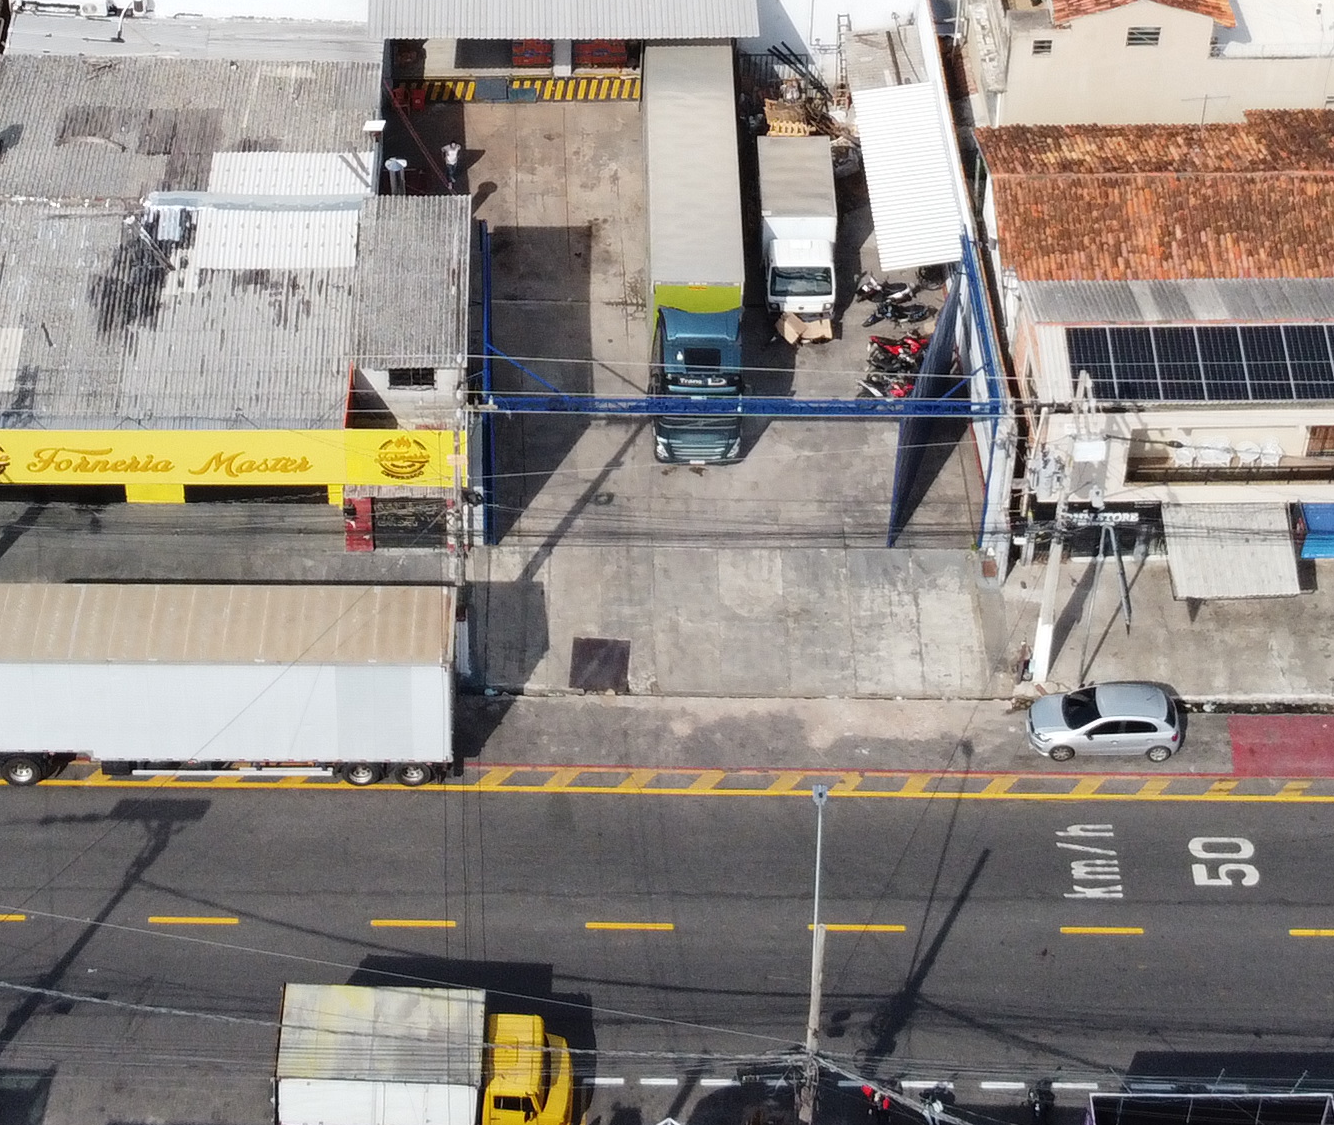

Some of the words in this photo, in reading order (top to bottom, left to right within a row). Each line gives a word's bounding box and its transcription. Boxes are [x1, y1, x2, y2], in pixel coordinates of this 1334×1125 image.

[26, 447, 175, 474] Forneria
[188, 451, 313, 477] Master
[1096, 511, 1140, 522] STORE
[1055, 824, 1124, 899] km/h
[1188, 837, 1261, 887] 50
